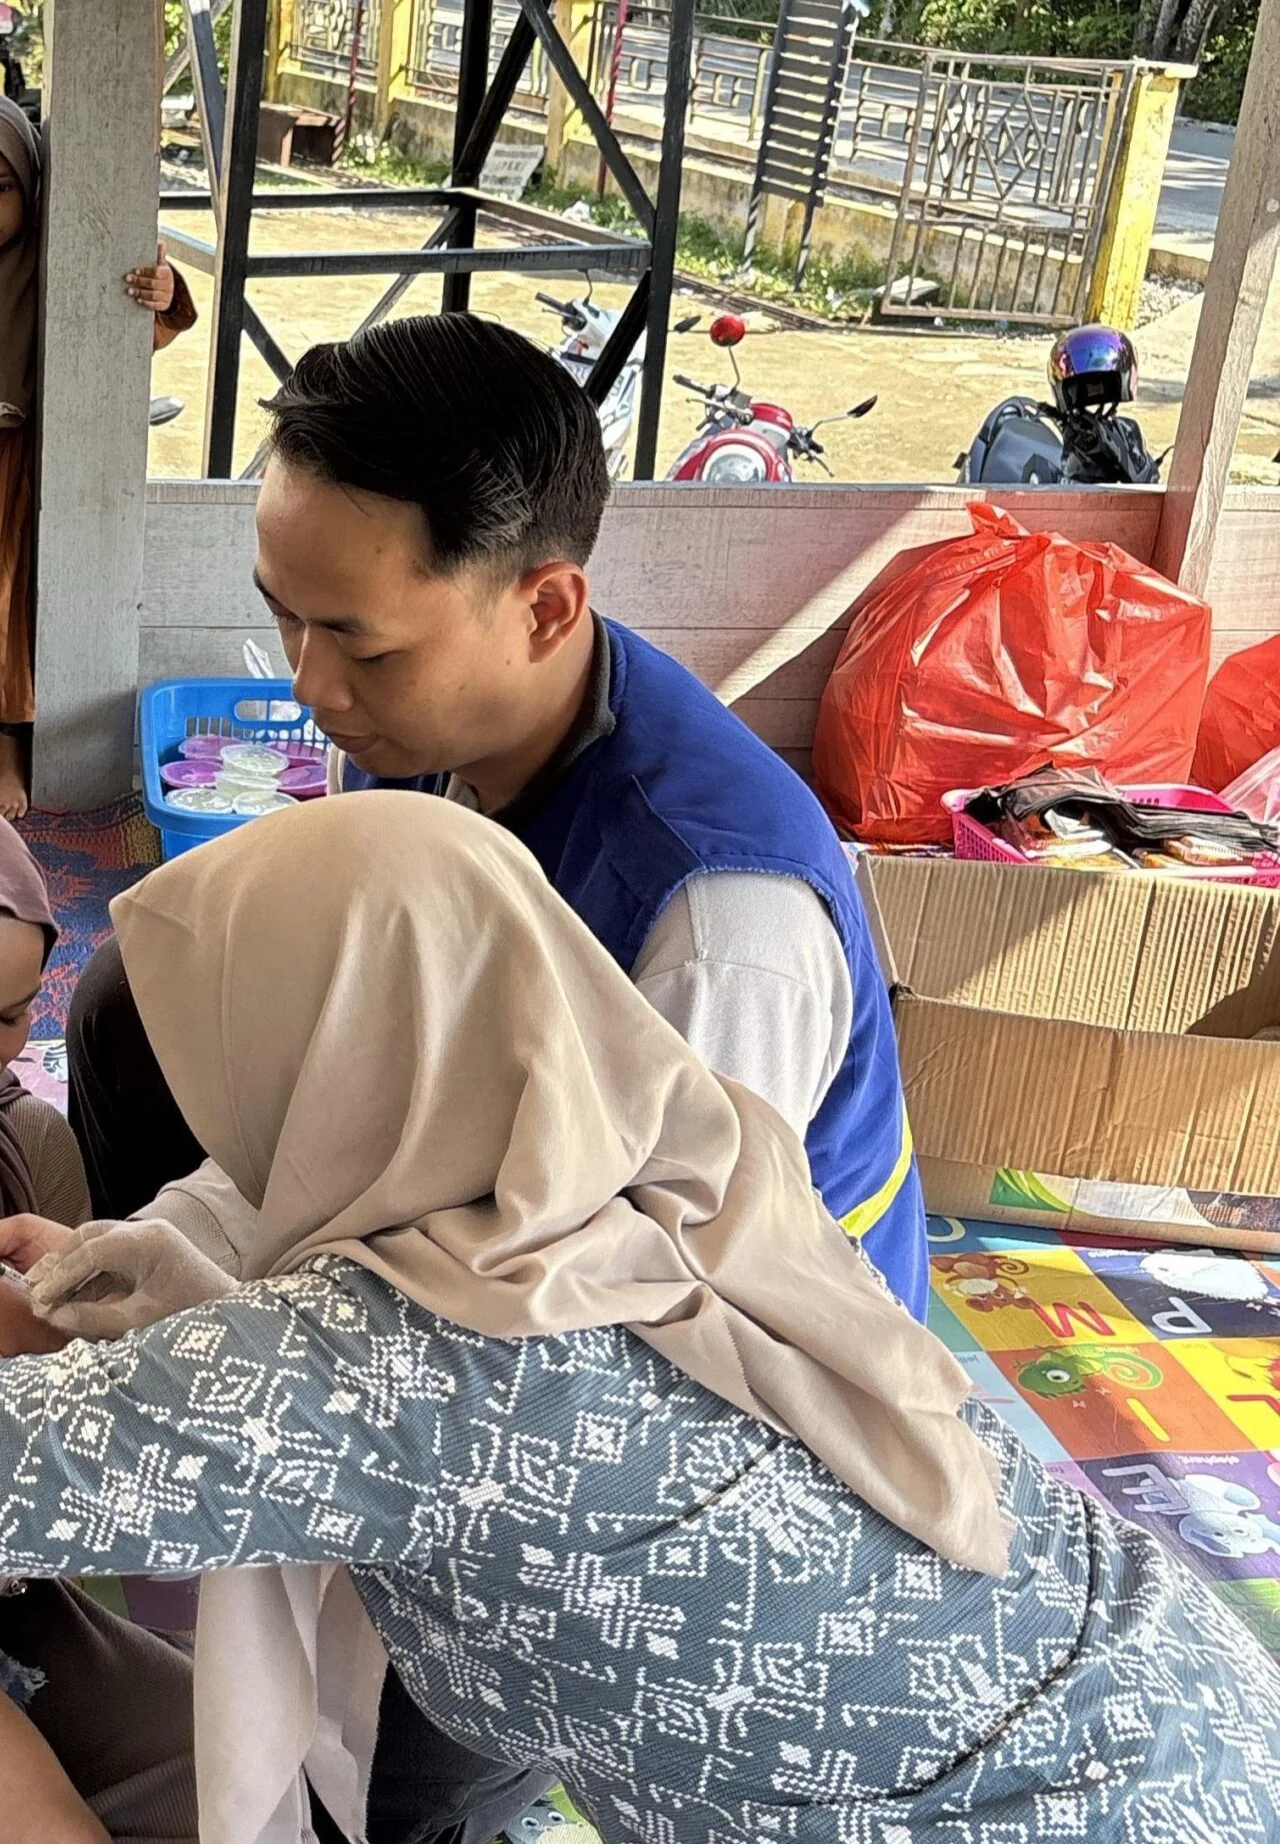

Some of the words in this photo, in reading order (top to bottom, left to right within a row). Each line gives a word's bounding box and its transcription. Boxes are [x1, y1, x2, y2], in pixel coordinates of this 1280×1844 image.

[1033, 1301, 1116, 1338] M
[1152, 1297, 1212, 1334] P
[1102, 1463, 1190, 1514] E
